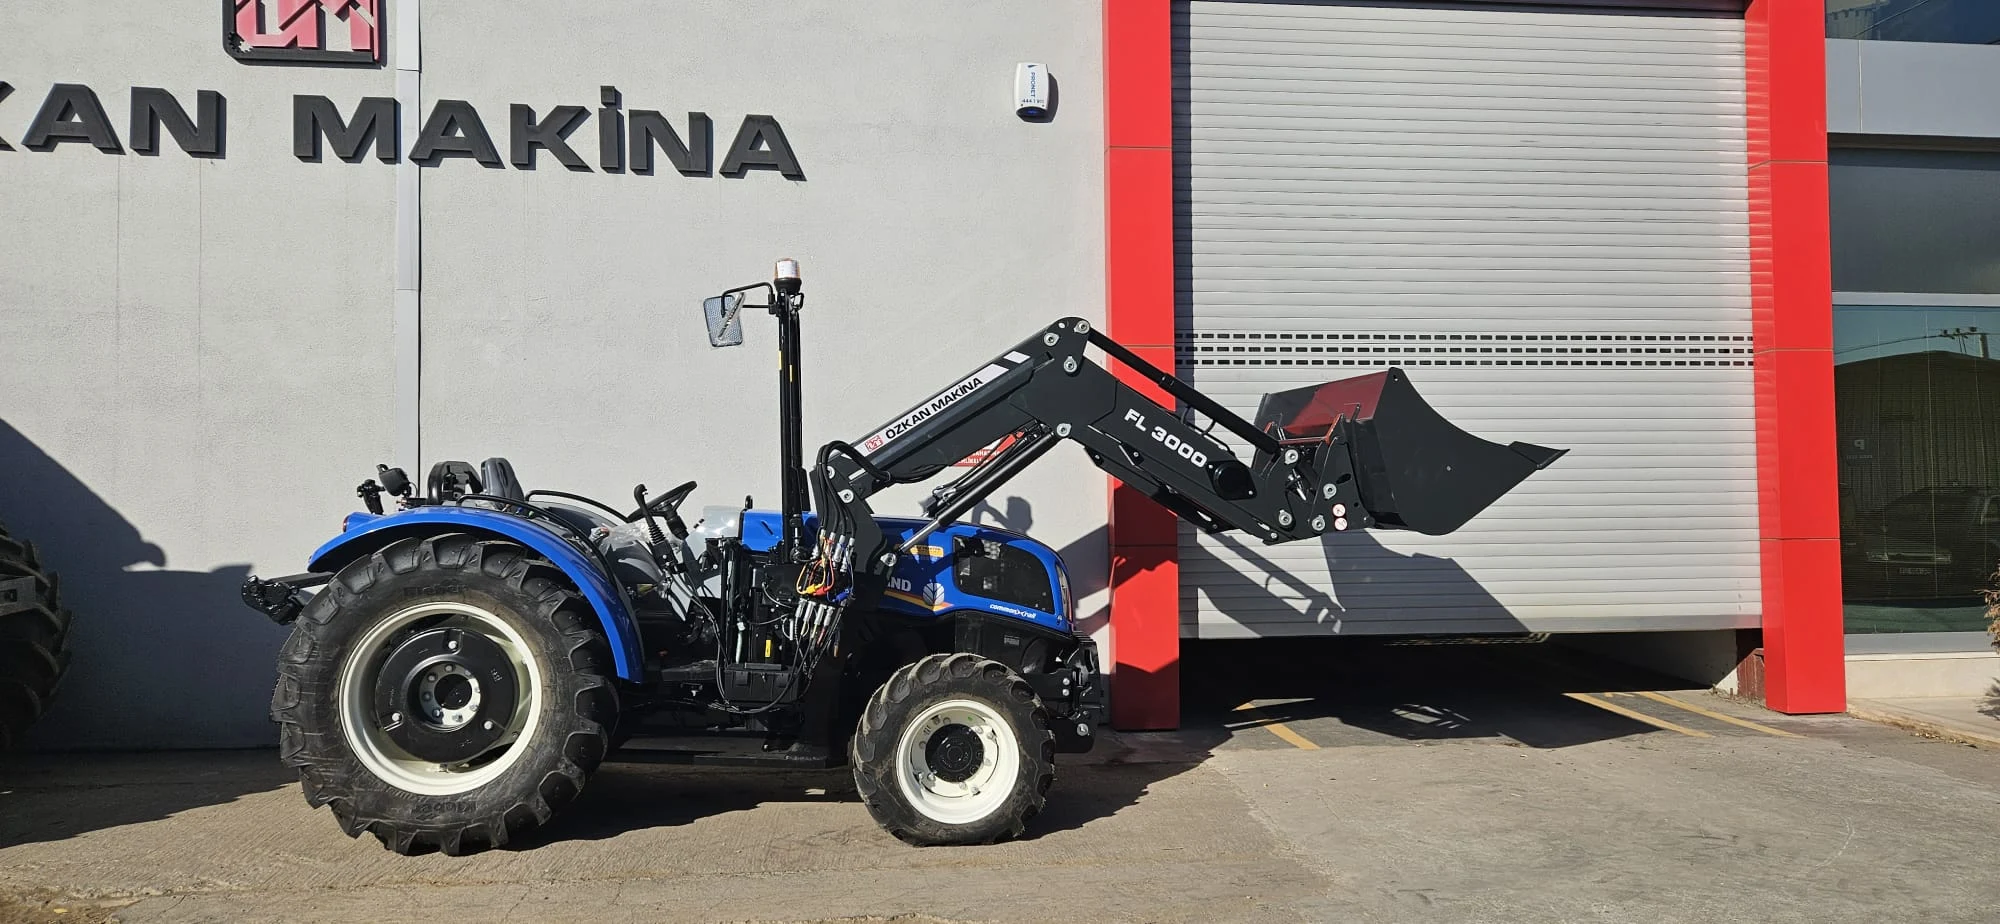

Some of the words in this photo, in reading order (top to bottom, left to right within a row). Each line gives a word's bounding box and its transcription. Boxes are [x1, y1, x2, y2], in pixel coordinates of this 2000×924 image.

[293, 86, 807, 181] MAKİNA
[931, 377, 983, 412] MAKİNA
[1125, 409, 1147, 431] FL
[1152, 427, 1207, 469] 3000
